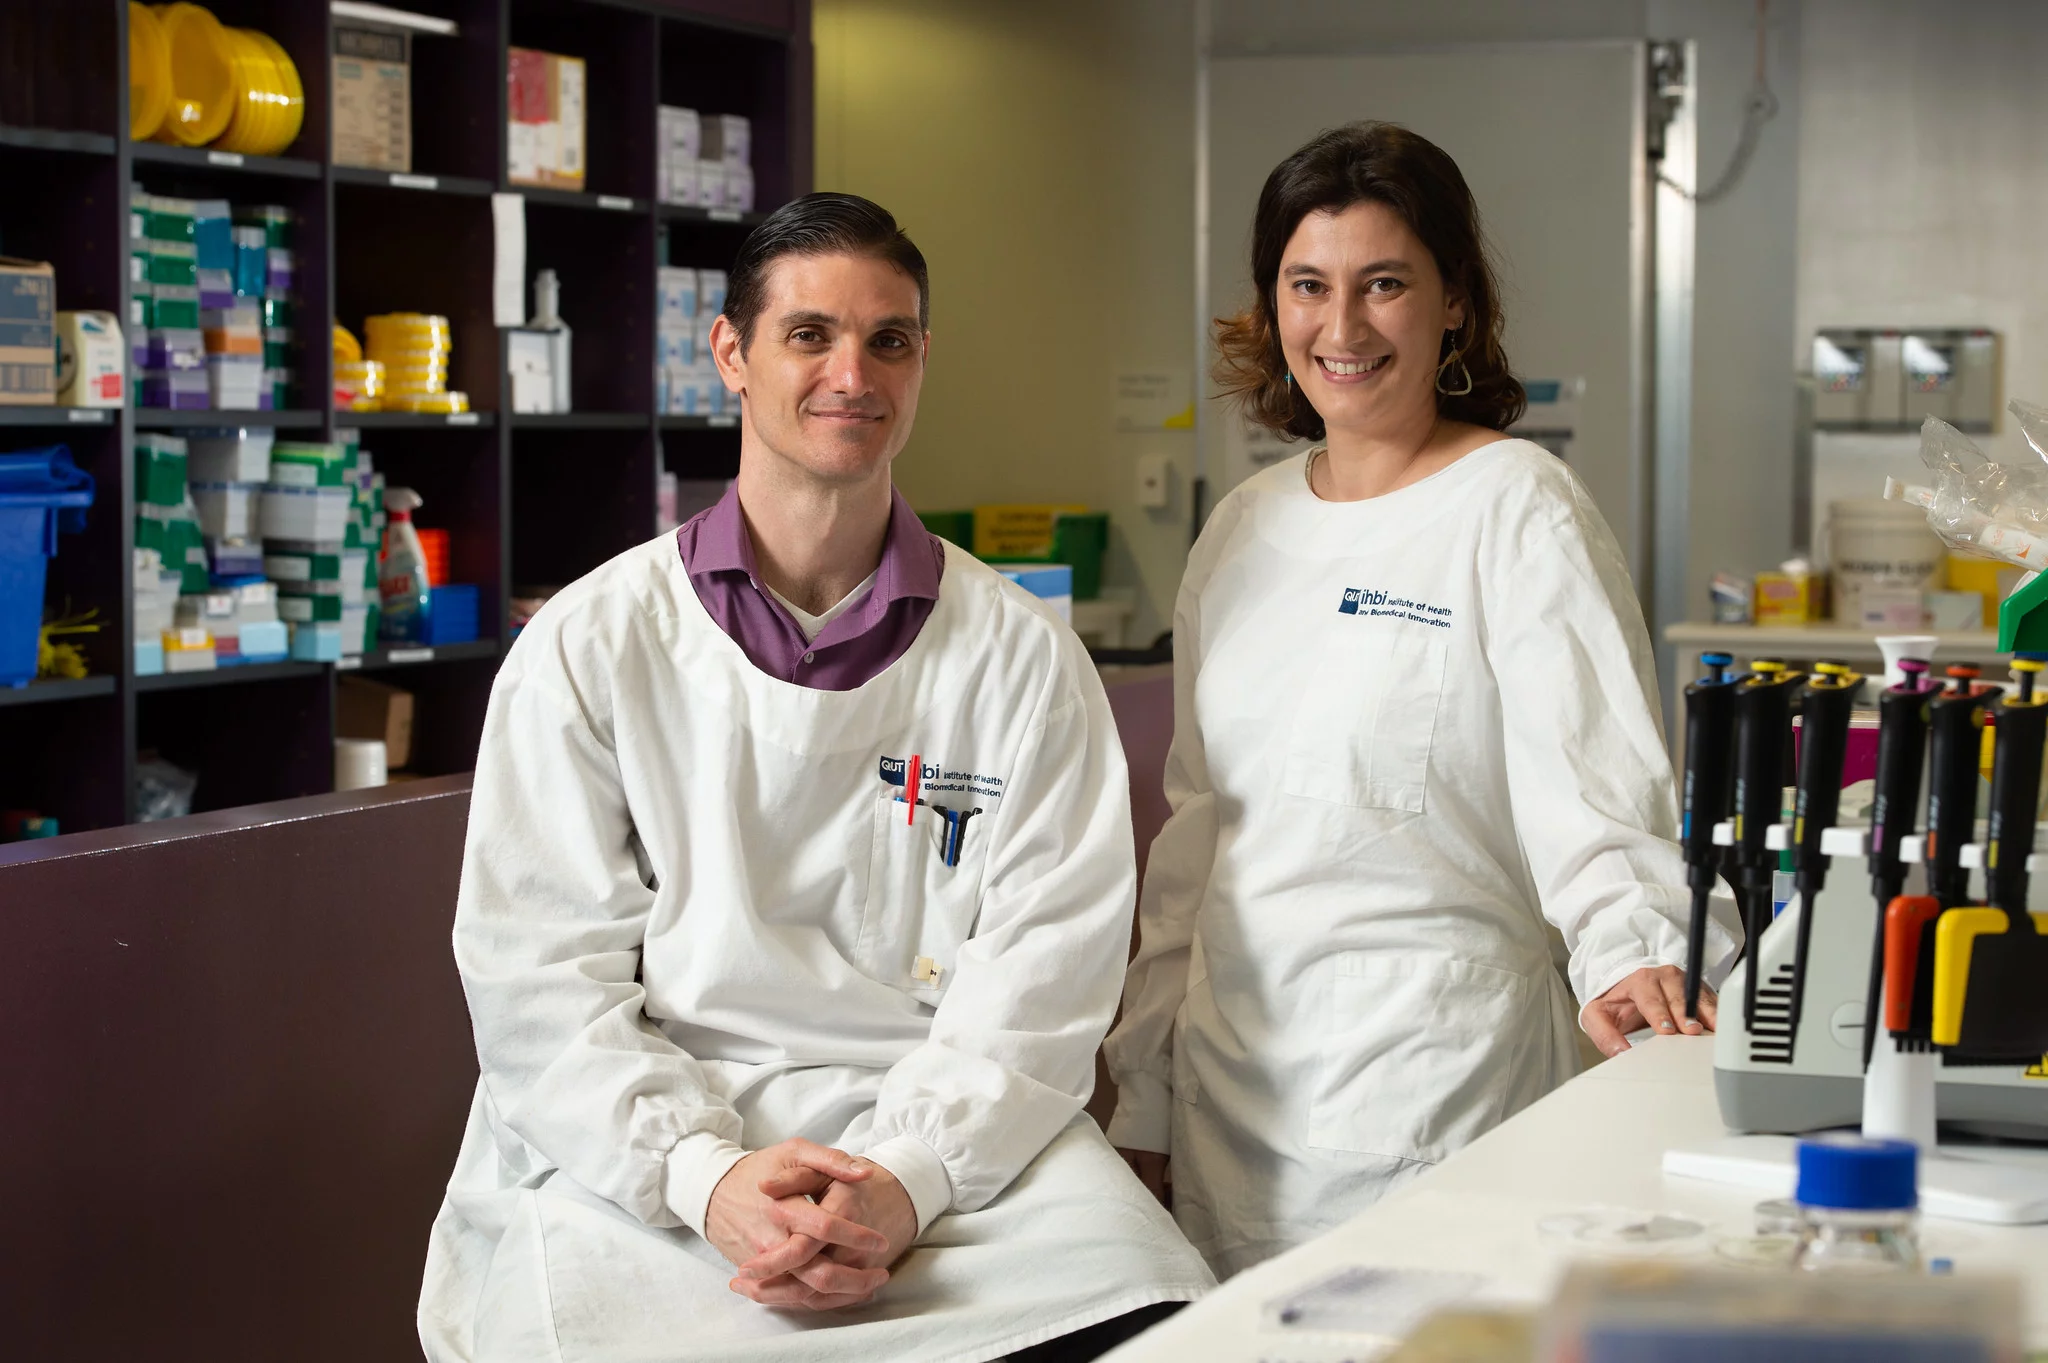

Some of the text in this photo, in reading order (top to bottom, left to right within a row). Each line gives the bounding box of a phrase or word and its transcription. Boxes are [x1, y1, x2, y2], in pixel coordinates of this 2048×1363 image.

[1361, 589, 1388, 605] ihbi
[1416, 603, 1426, 611] of
[1427, 606, 1452, 617] Health
[1370, 608, 1406, 618] Biomedical
[1408, 613, 1451, 629] Innovation
[881, 760, 904, 773] QUT
[924, 782, 965, 792] Biomedical
